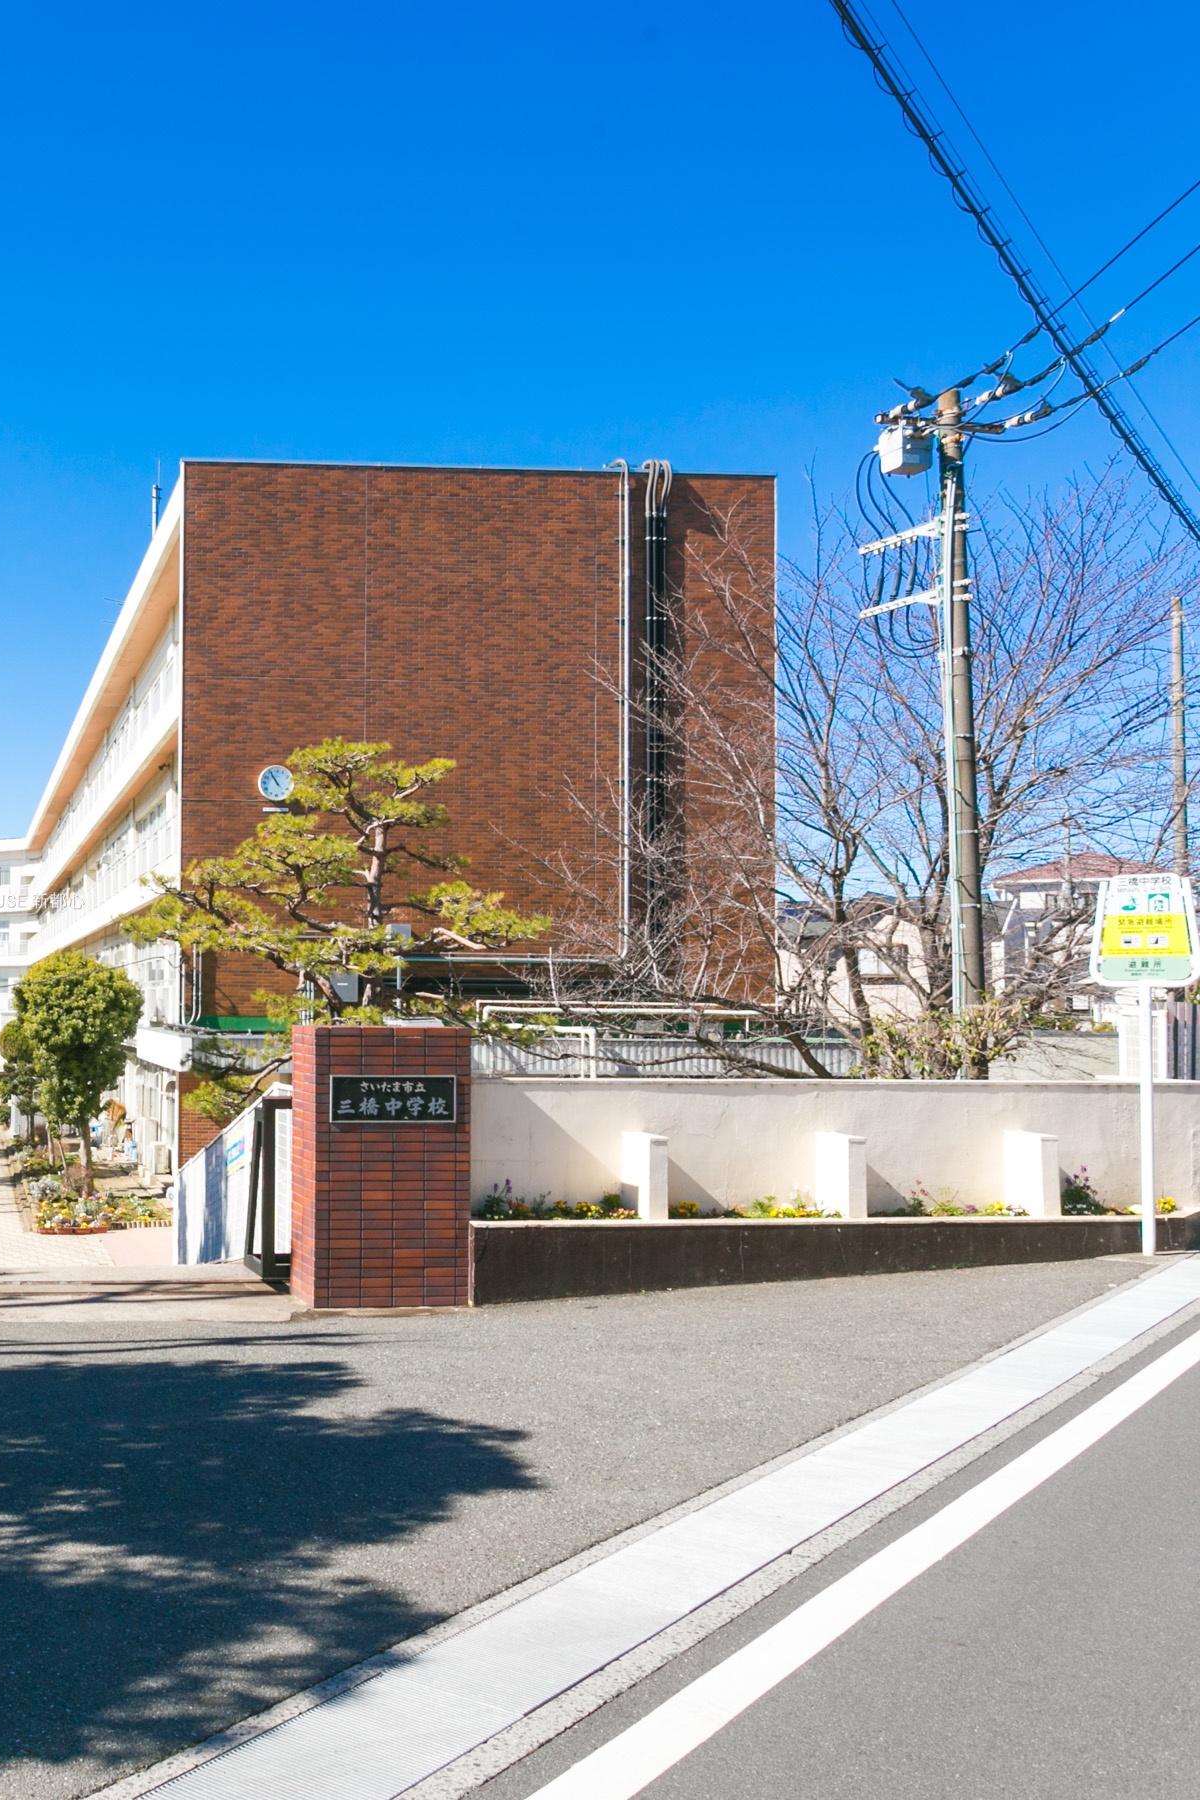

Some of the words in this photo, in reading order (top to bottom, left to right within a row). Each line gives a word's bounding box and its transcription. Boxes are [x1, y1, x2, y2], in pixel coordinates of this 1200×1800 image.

[1117, 876, 1171, 886] 三橋中学校
[360, 1081, 427, 1094] さいたま市立
[337, 1096, 449, 1117] 三橋中学校
